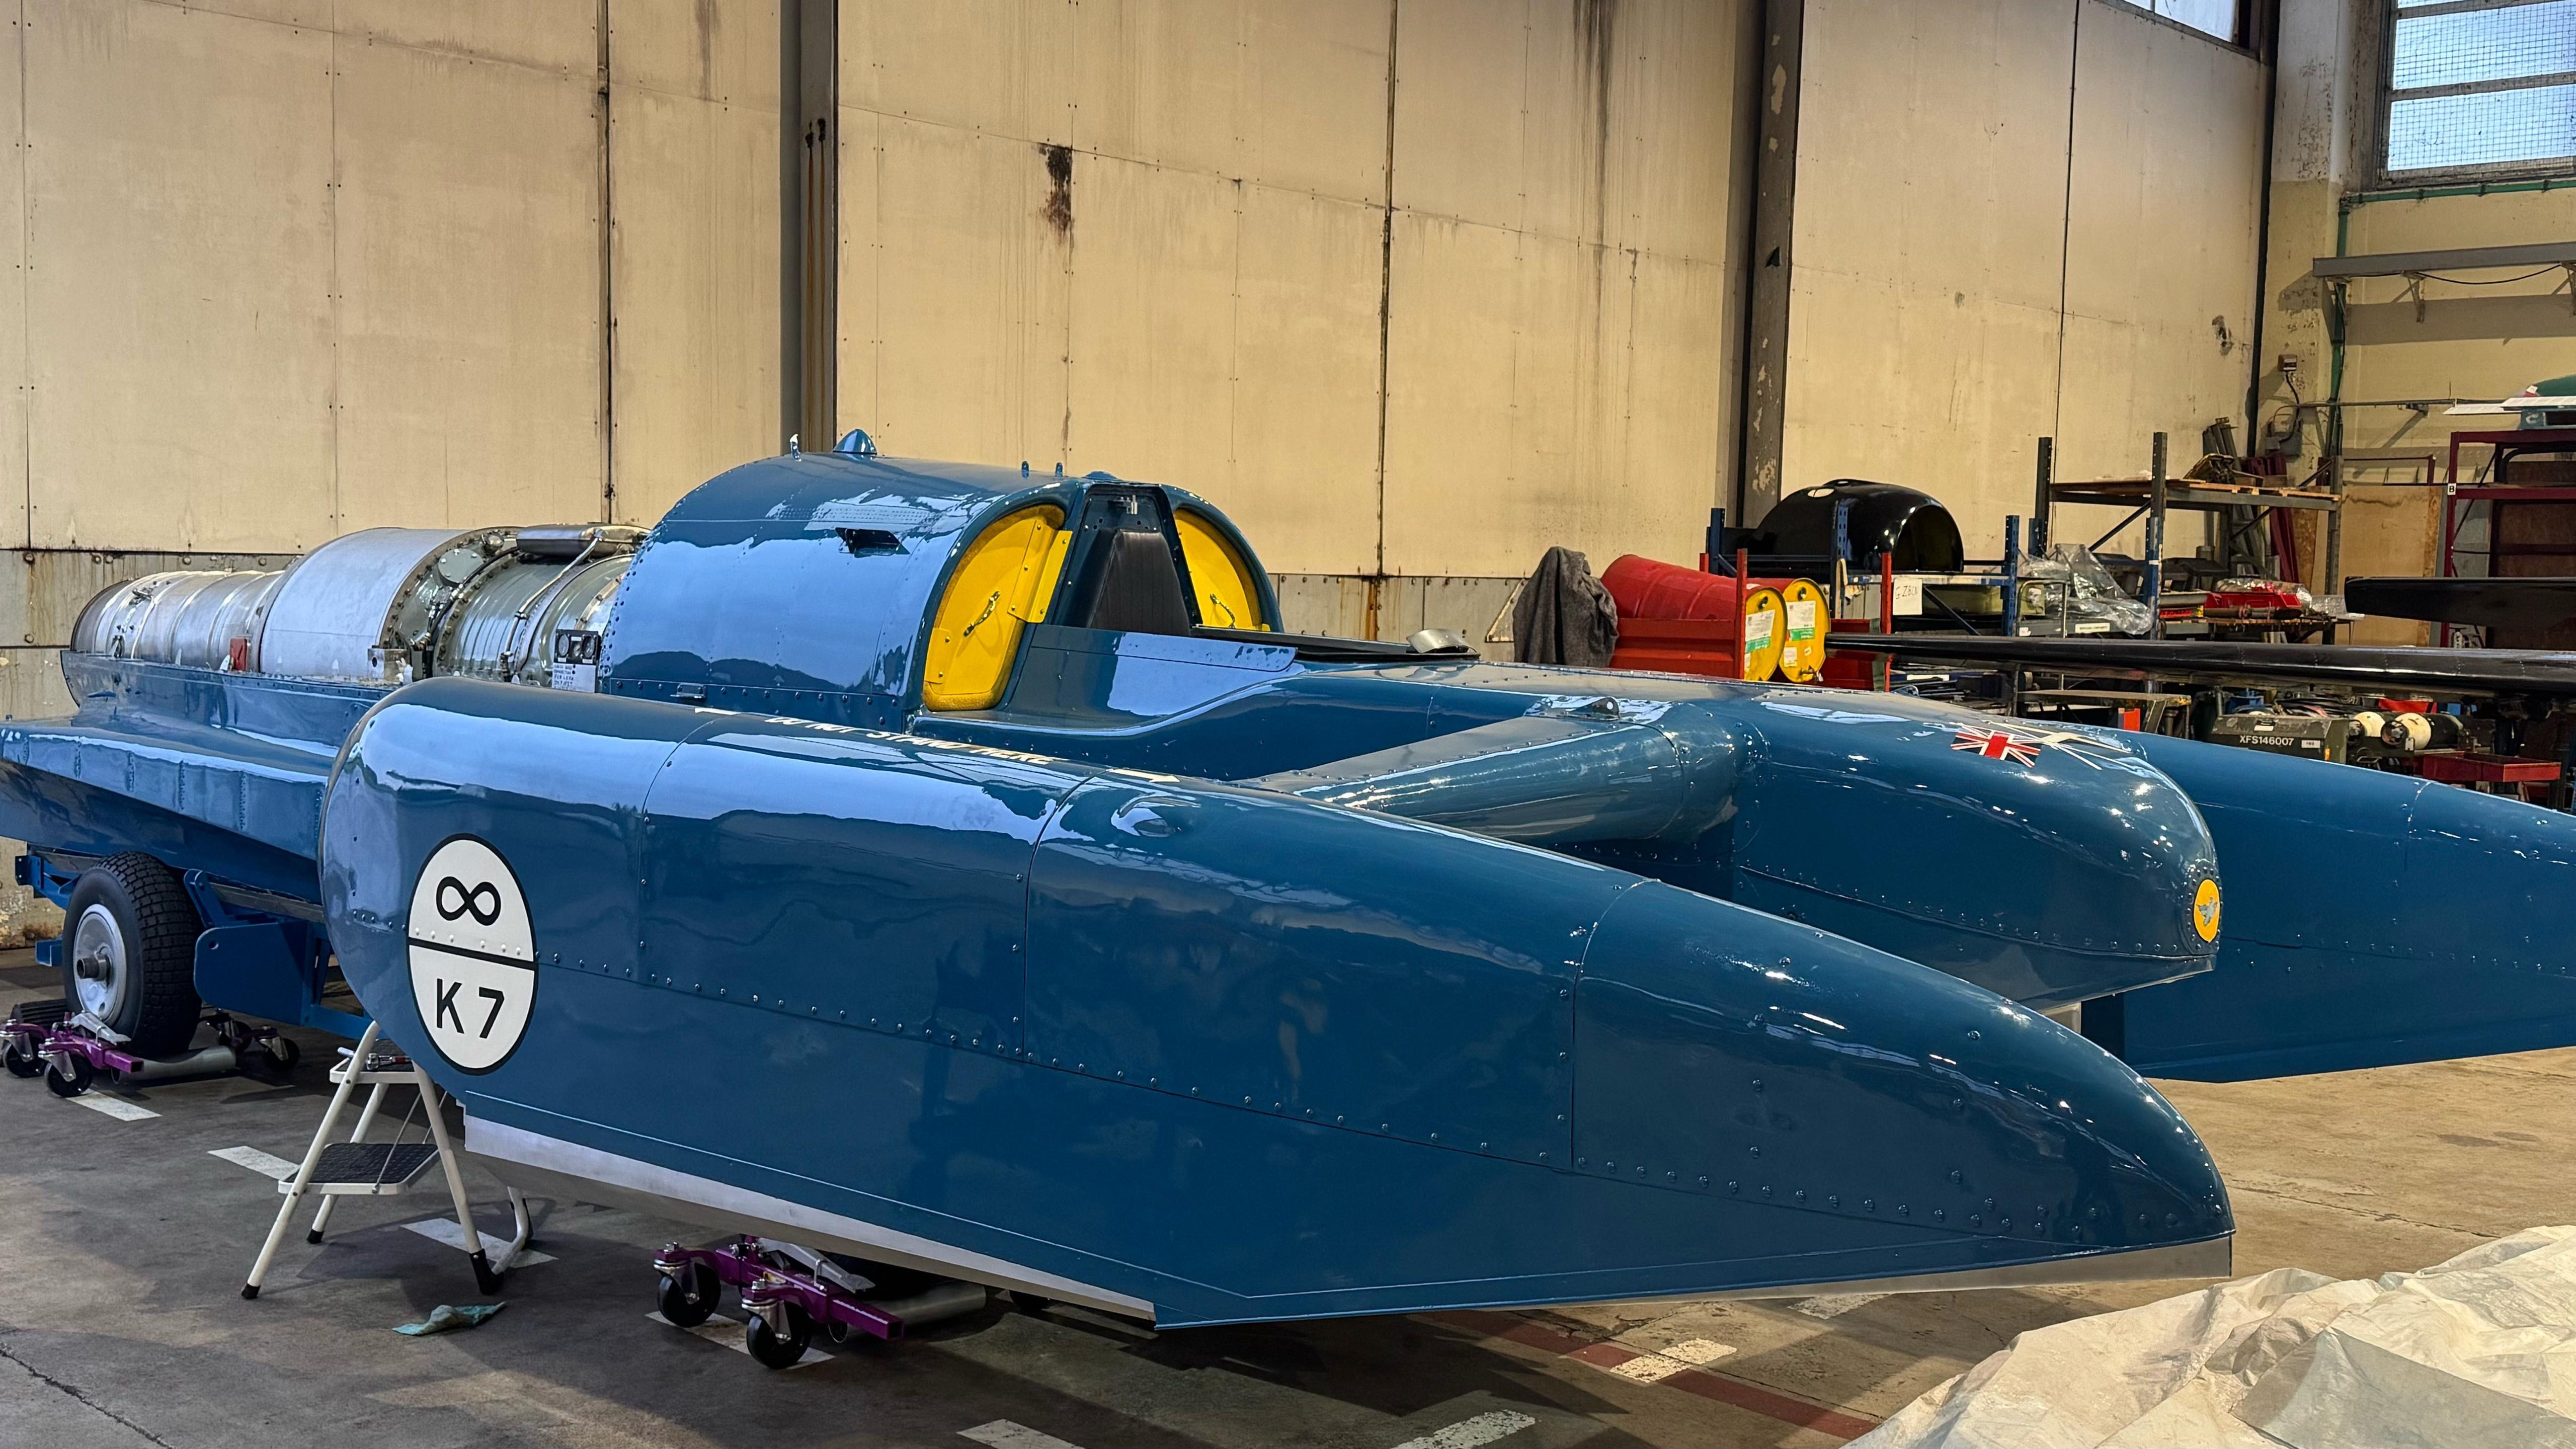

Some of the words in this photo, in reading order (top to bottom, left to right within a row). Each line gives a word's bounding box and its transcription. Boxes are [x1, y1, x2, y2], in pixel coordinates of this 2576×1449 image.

[866, 731, 971, 750] STAND
[969, 747, 1070, 765] HERE
[2240, 735, 2294, 746] XFS146007
